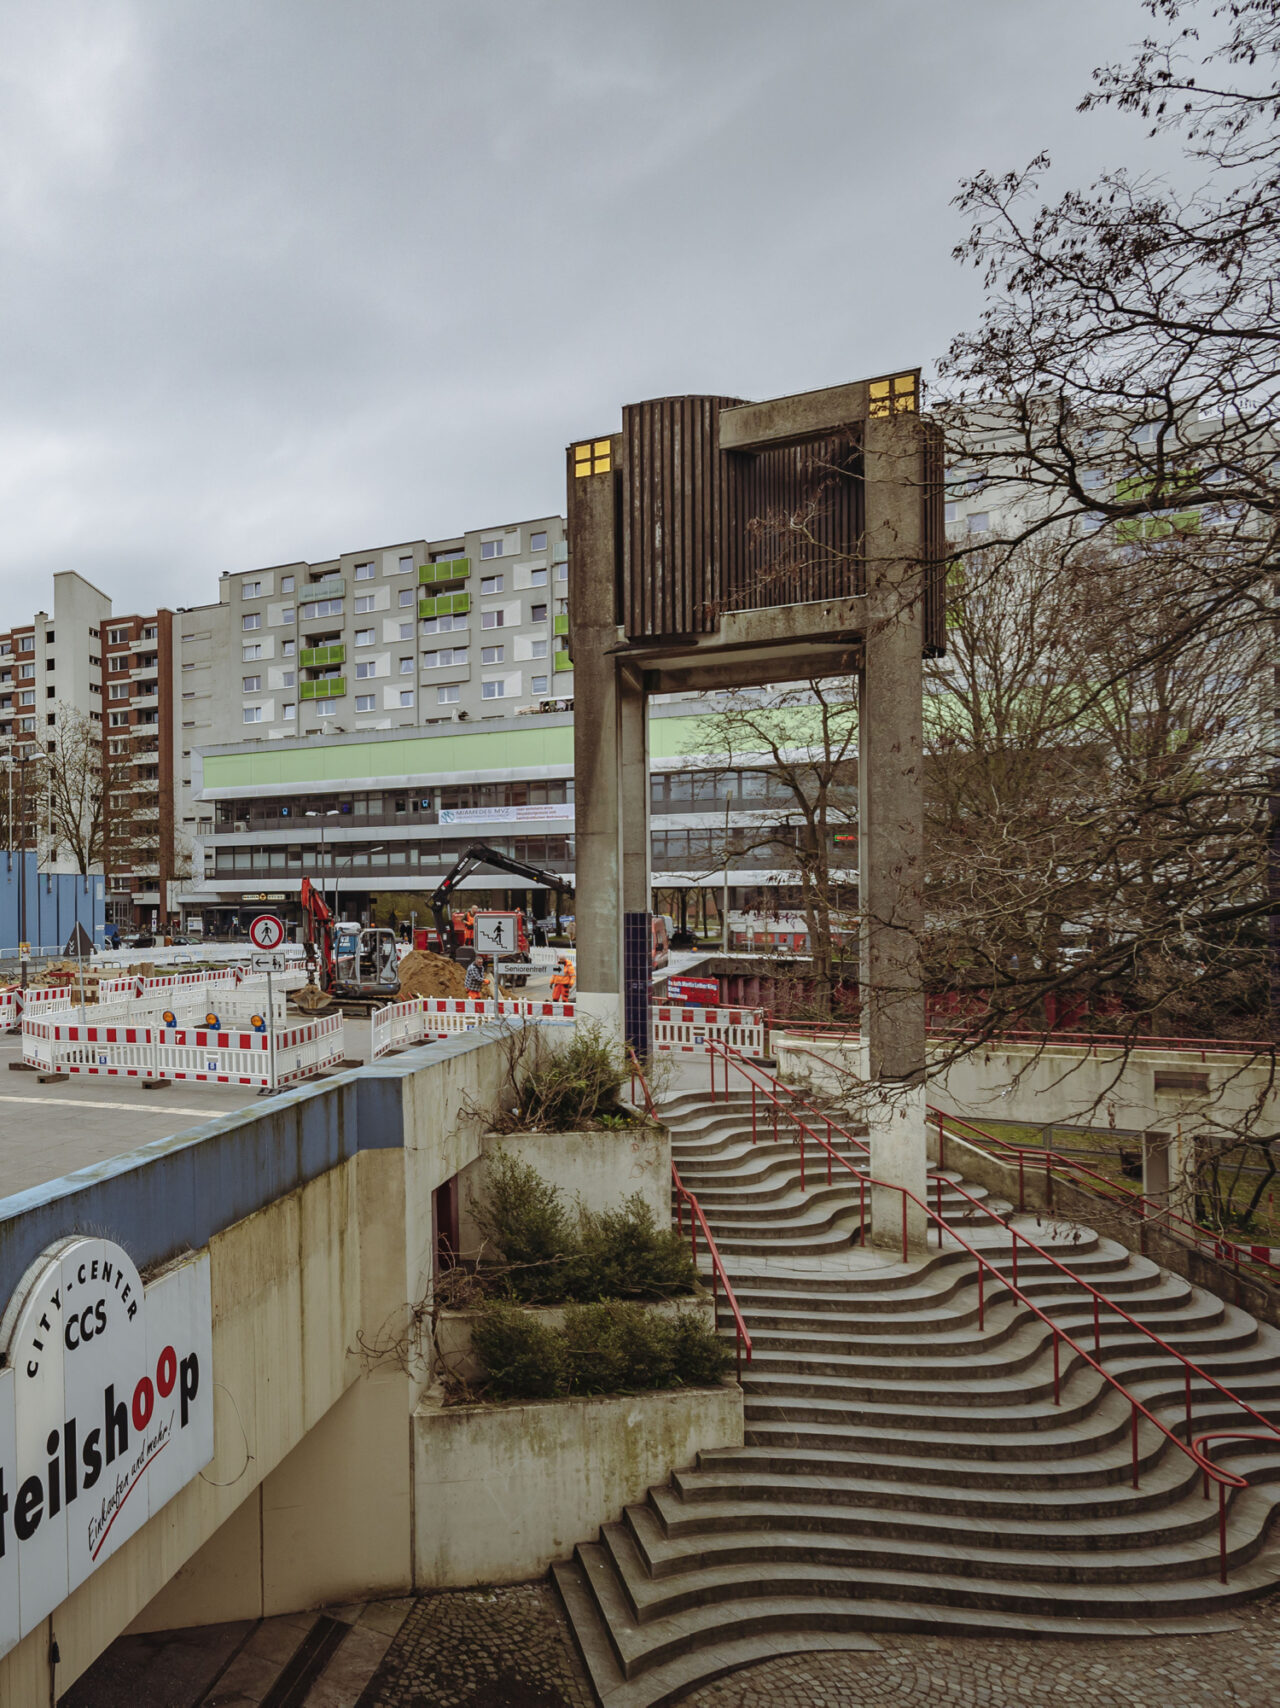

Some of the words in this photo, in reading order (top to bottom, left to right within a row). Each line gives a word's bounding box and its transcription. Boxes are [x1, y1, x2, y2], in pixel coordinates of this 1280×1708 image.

[504, 965, 547, 973] Seniorentreff
[26, 1259, 138, 1378] CITY-CENTER
[64, 1298, 107, 1351] CCS
[88, 1473, 129, 1552] Einkaufen
[131, 1438, 145, 1476] und
[147, 1409, 174, 1457] mehr!
